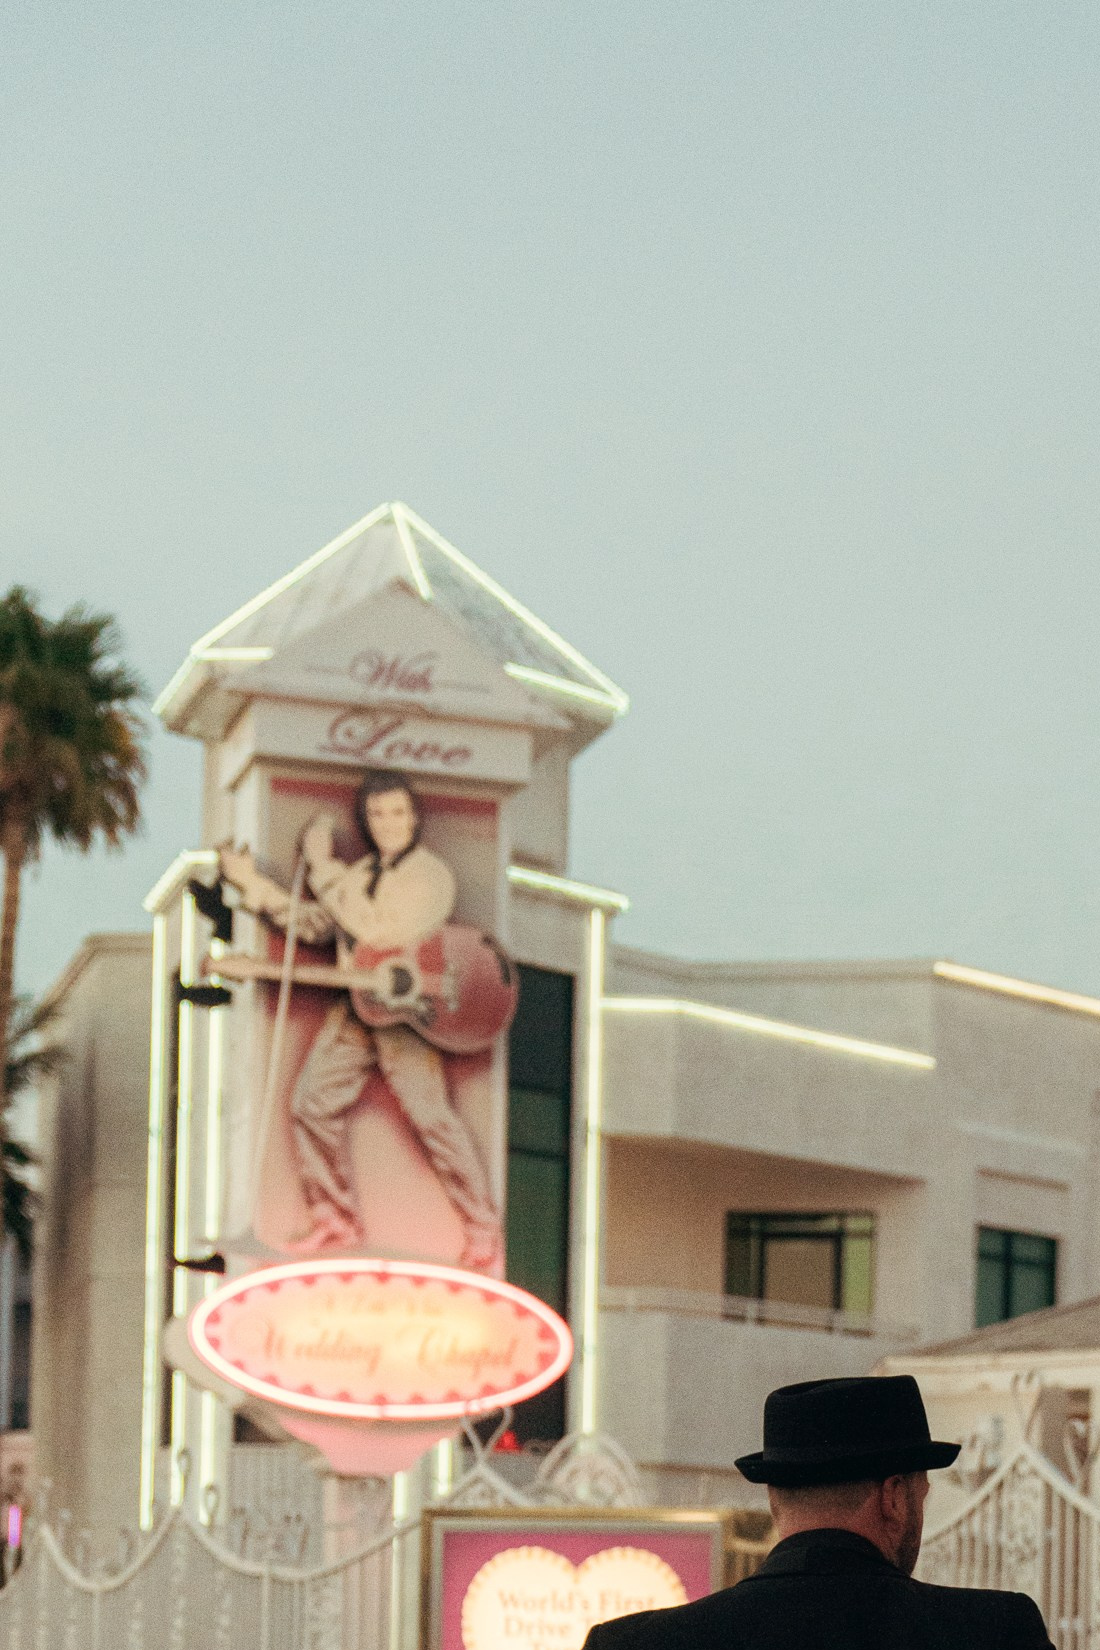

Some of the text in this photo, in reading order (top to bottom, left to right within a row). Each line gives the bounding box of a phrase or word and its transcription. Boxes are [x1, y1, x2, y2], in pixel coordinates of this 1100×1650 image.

[316, 700, 474, 767] Love
[230, 1313, 520, 1380] Wedding Chapel
[497, 1588, 656, 1614] World's First
[503, 1615, 573, 1638] Drive
